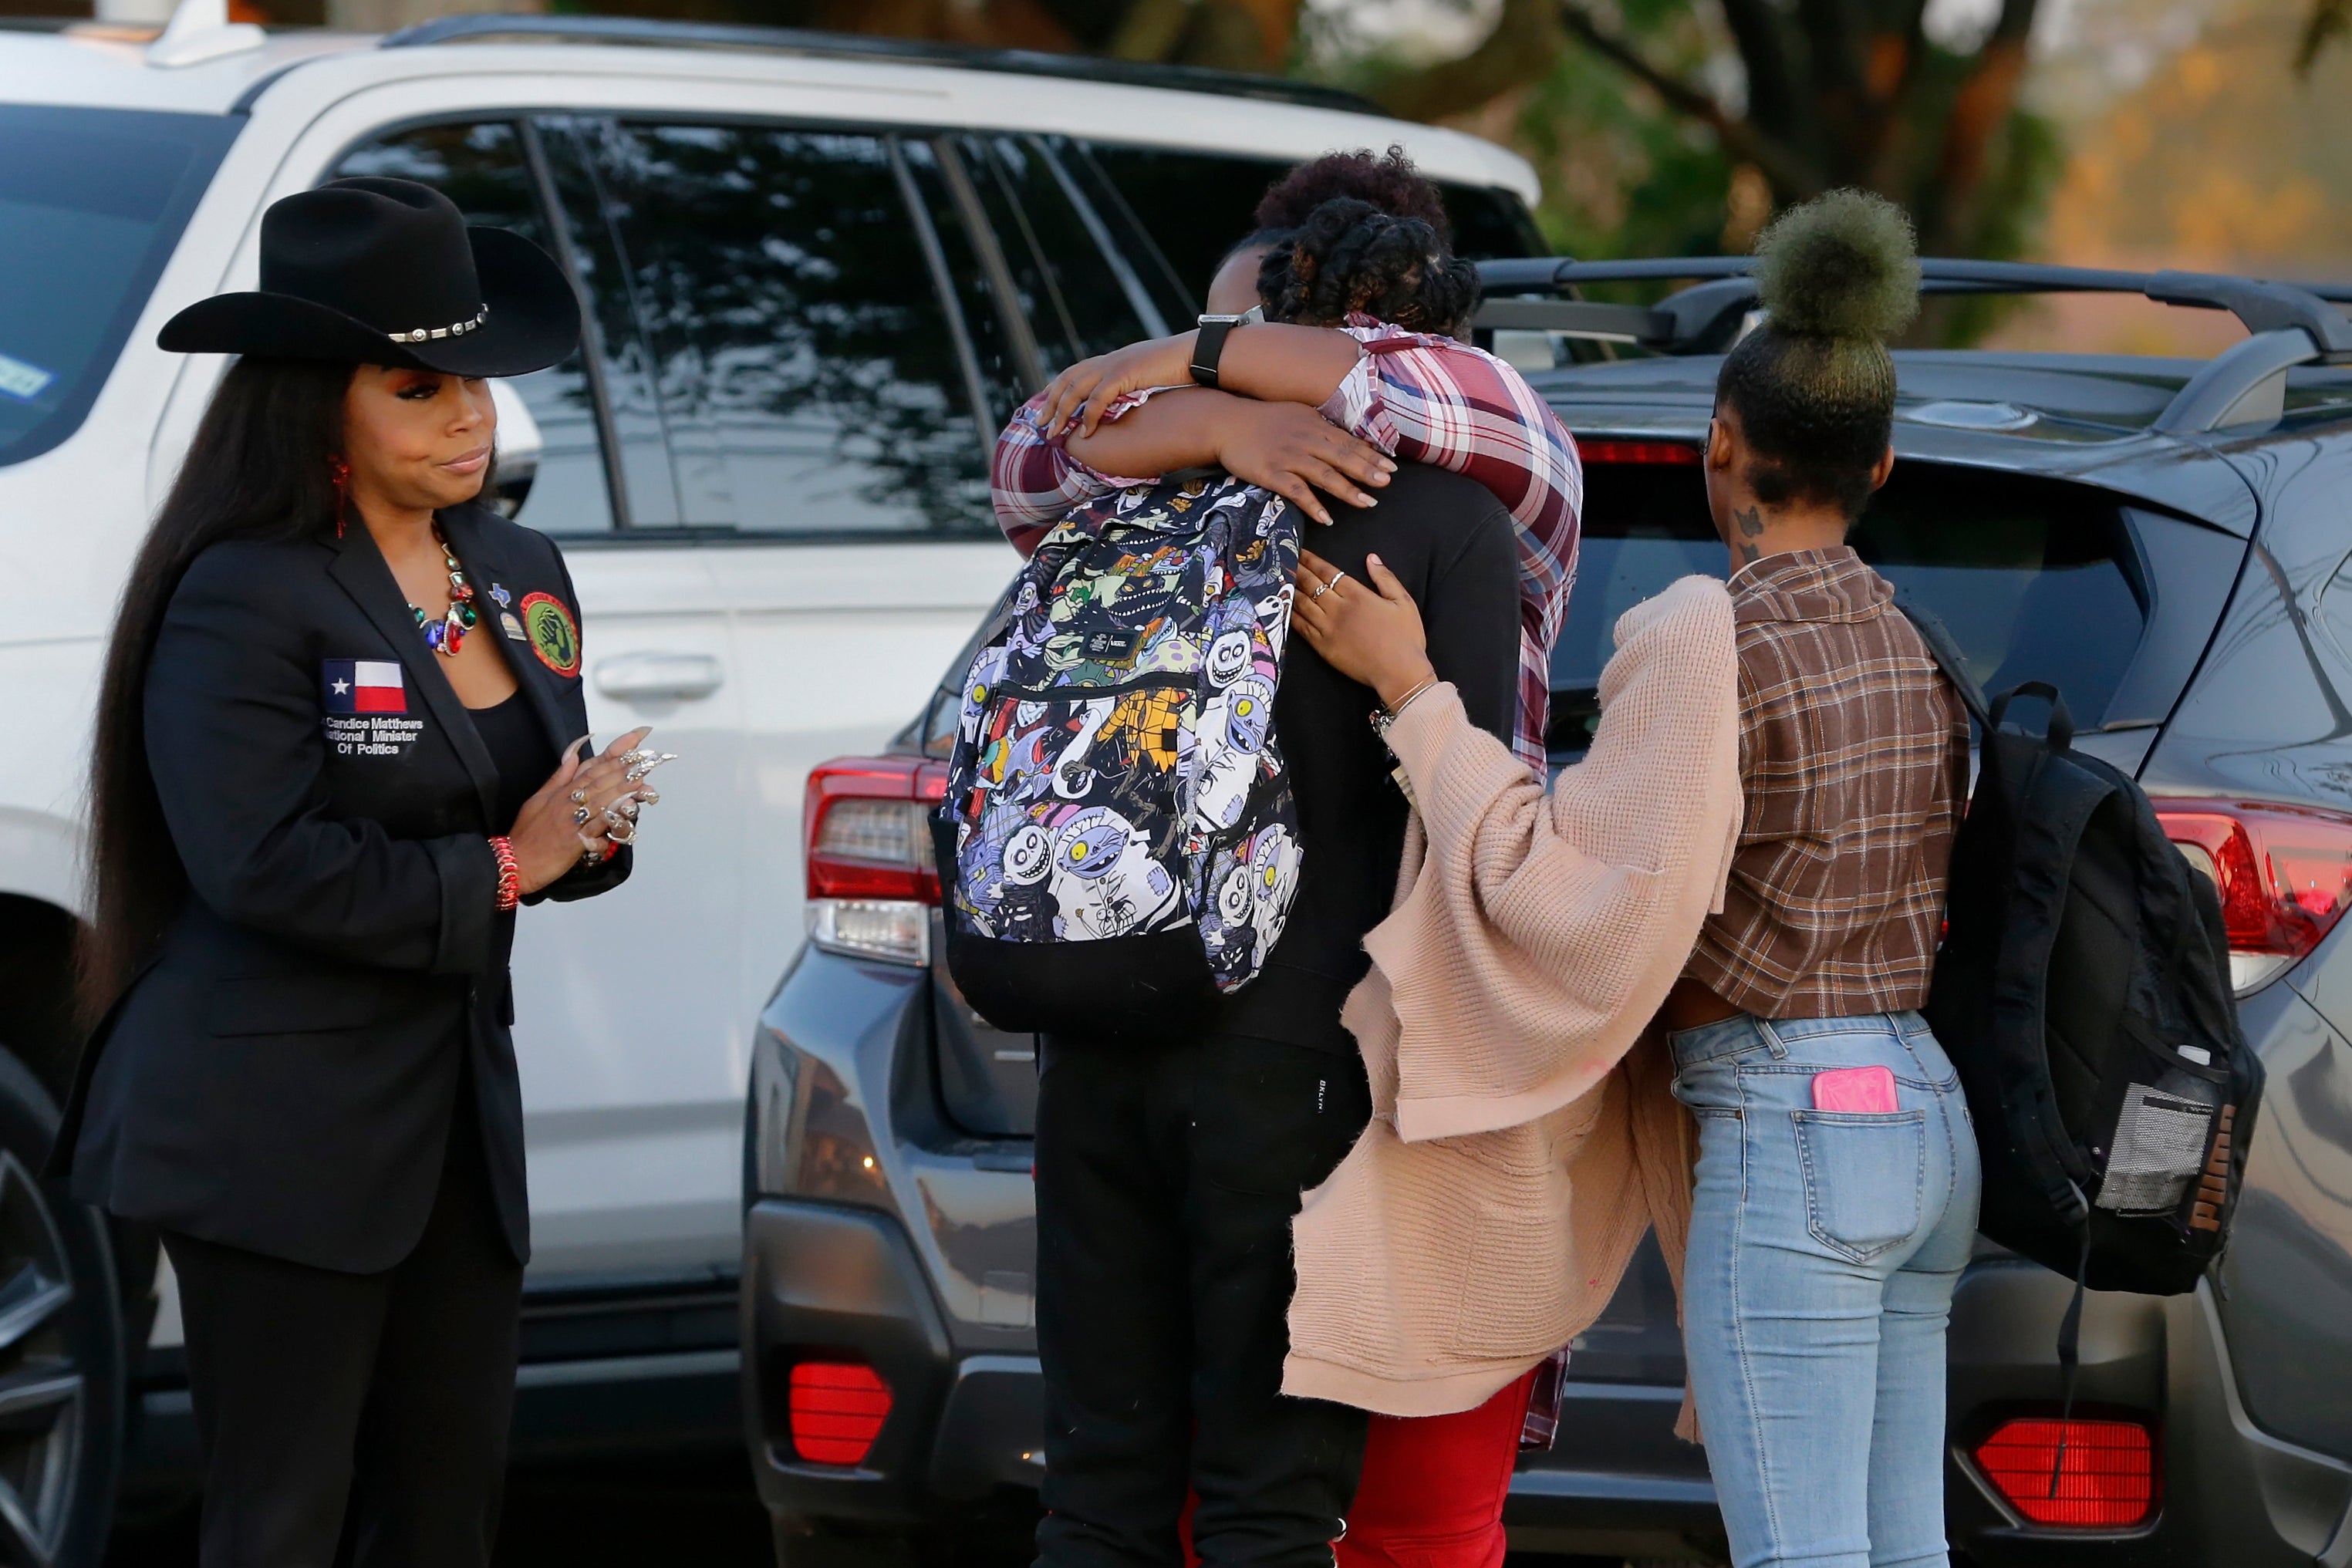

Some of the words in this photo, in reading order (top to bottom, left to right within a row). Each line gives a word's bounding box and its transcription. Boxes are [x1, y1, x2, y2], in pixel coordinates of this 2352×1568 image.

[326, 717, 370, 729] Candice
[371, 718, 423, 730] Matthews
[372, 730, 417, 742] Minister
[337, 743, 353, 754] Of
[357, 744, 399, 755] Politics
[2188, 1103, 2236, 1232] PUMA
